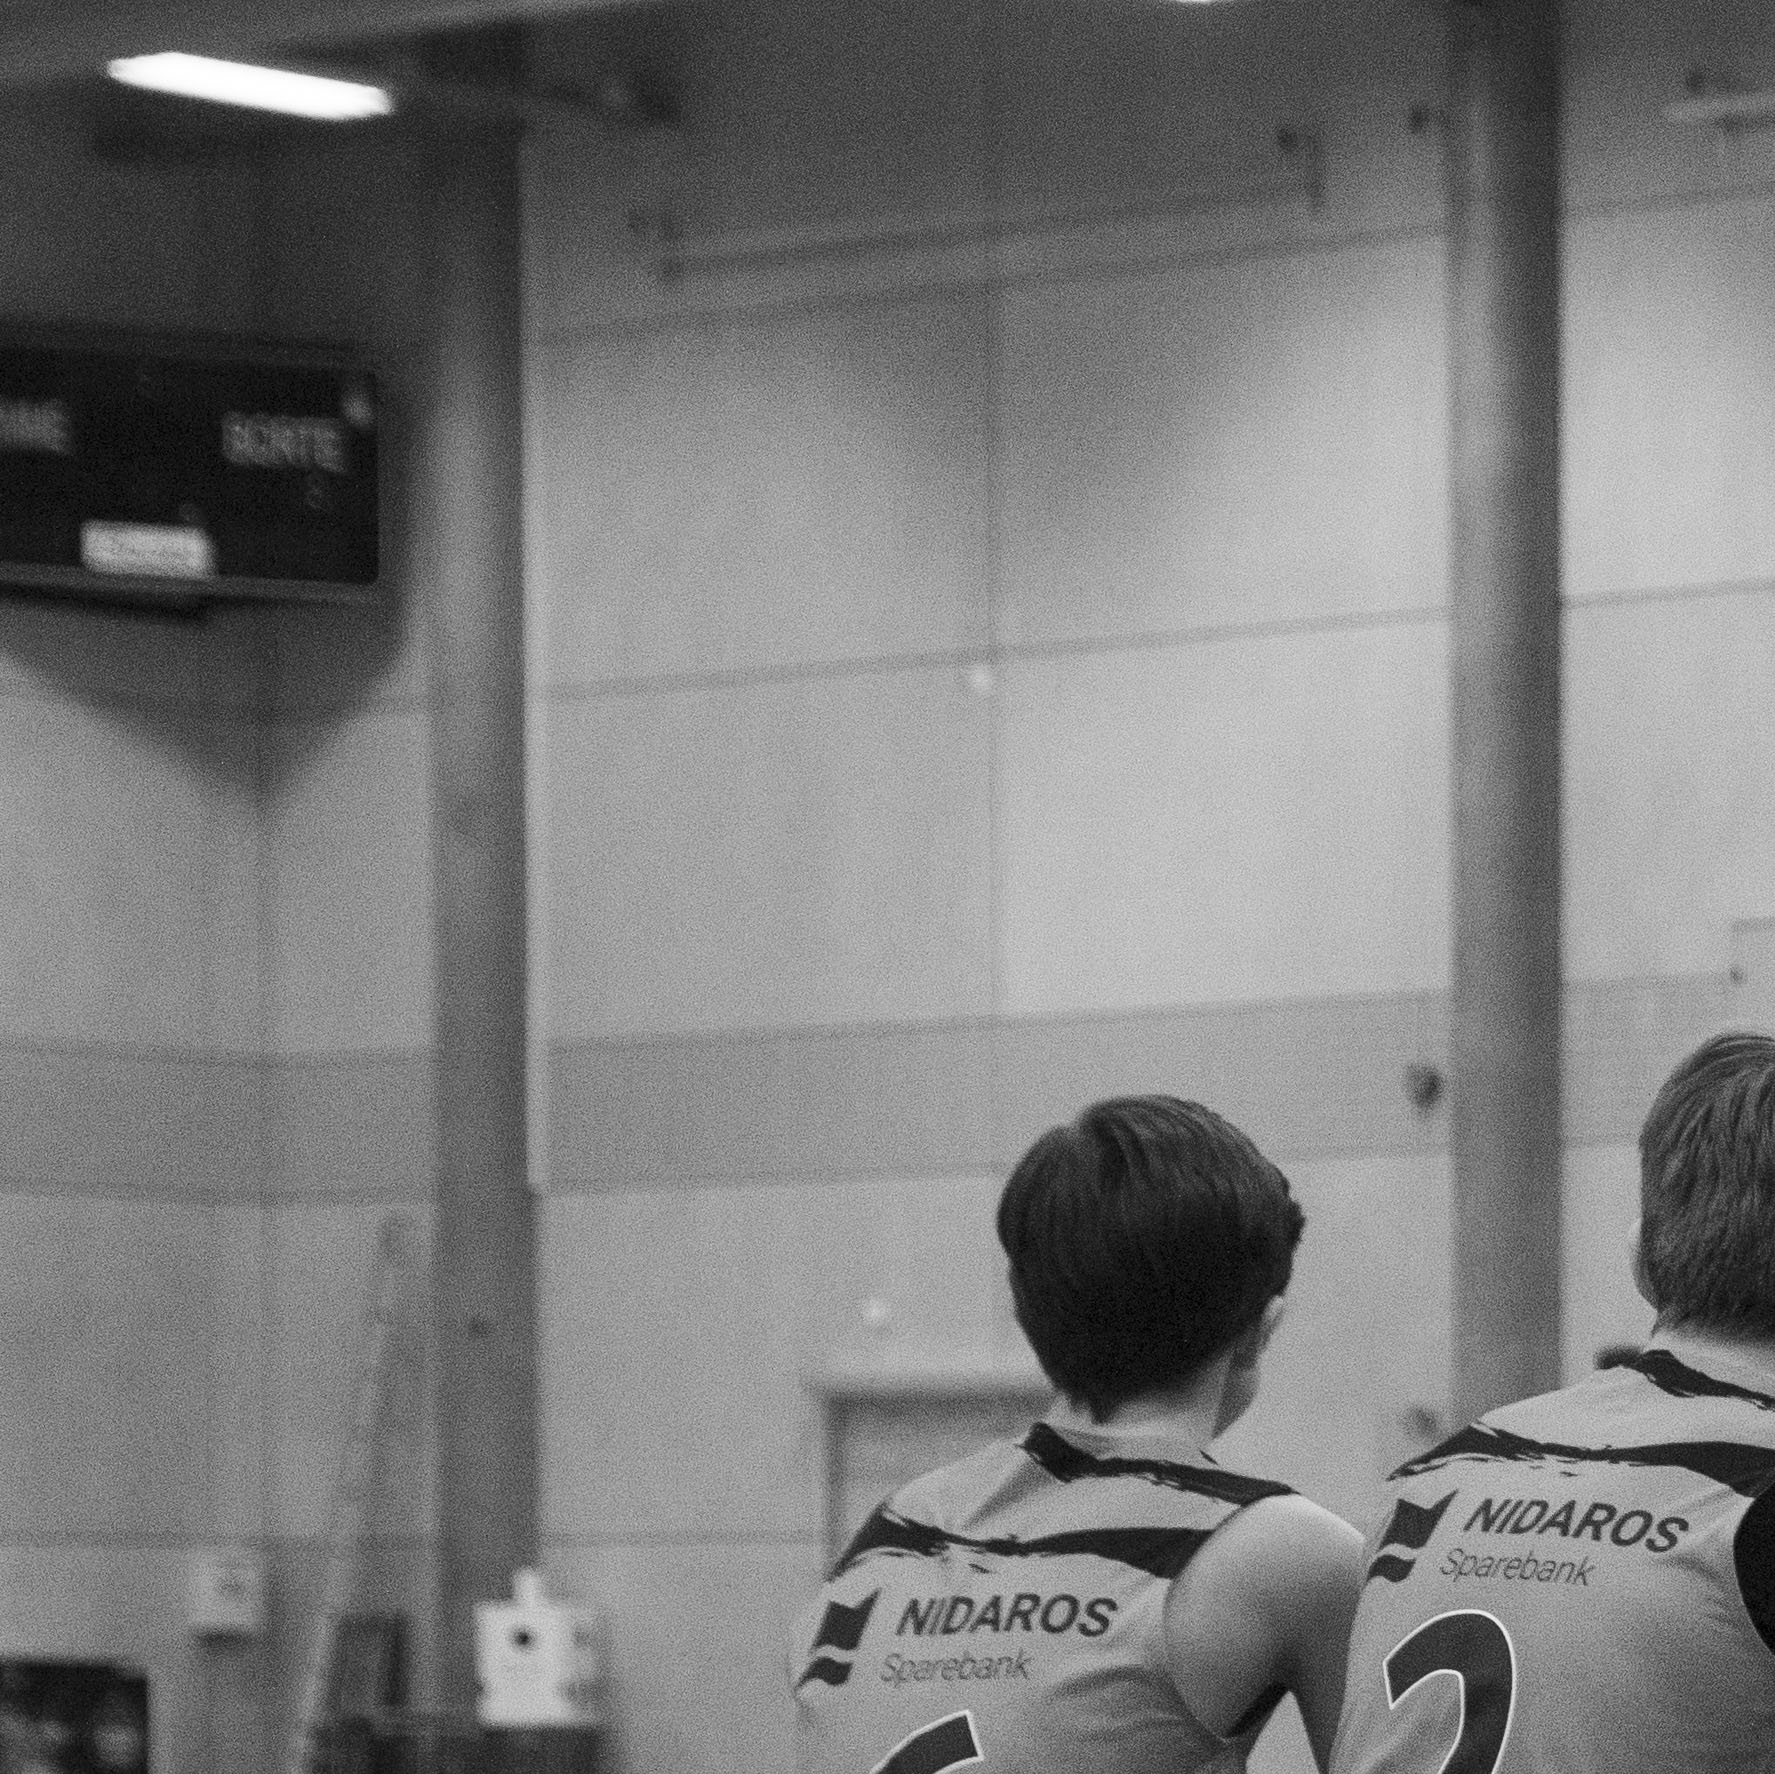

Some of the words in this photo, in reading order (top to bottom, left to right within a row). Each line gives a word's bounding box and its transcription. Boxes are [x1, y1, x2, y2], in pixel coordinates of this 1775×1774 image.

[1463, 1497, 1690, 1554] NIDAROS
[1438, 1547, 1596, 1588] Sparebank
[895, 1590, 1118, 1639] NIDAROS
[878, 1646, 1035, 1688] Sparebank
